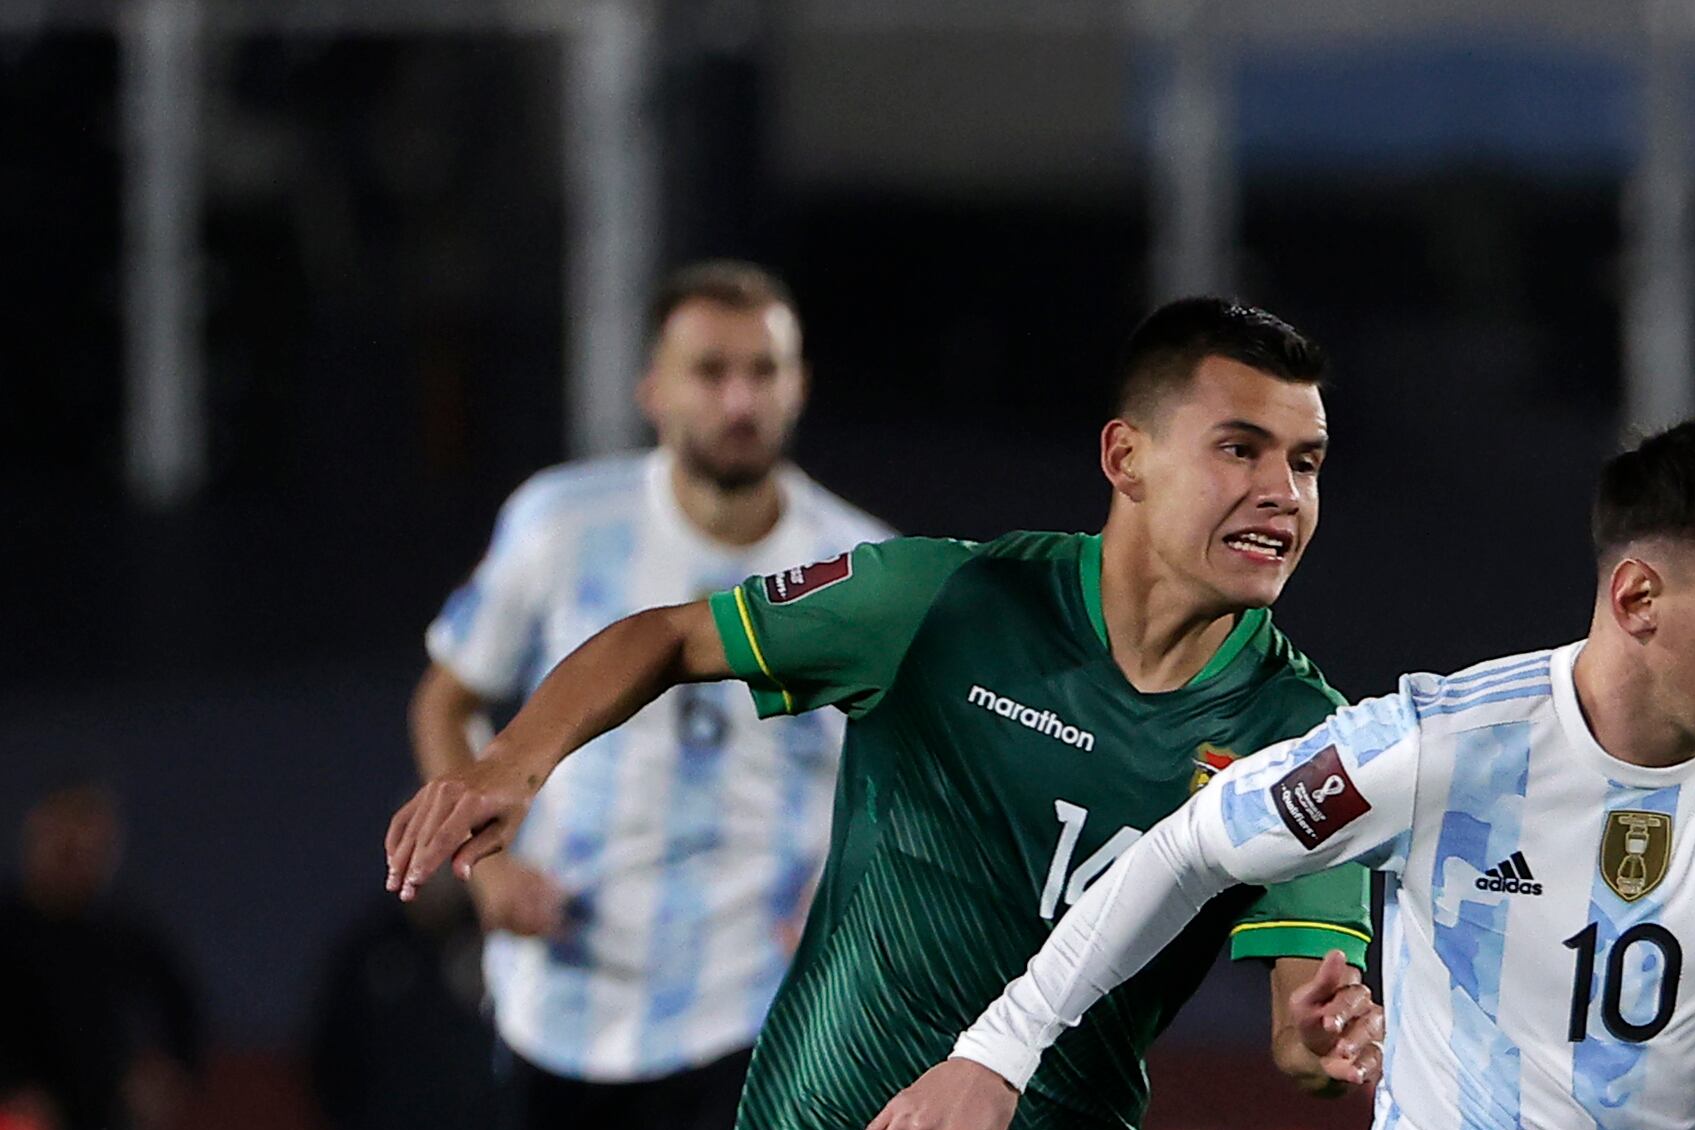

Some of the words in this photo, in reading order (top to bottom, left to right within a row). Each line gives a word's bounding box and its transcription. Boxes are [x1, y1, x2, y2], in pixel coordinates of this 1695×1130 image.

[967, 684, 1096, 752] marathon
[1475, 876, 1543, 896] adidas
[1561, 920, 1683, 1043] 10
